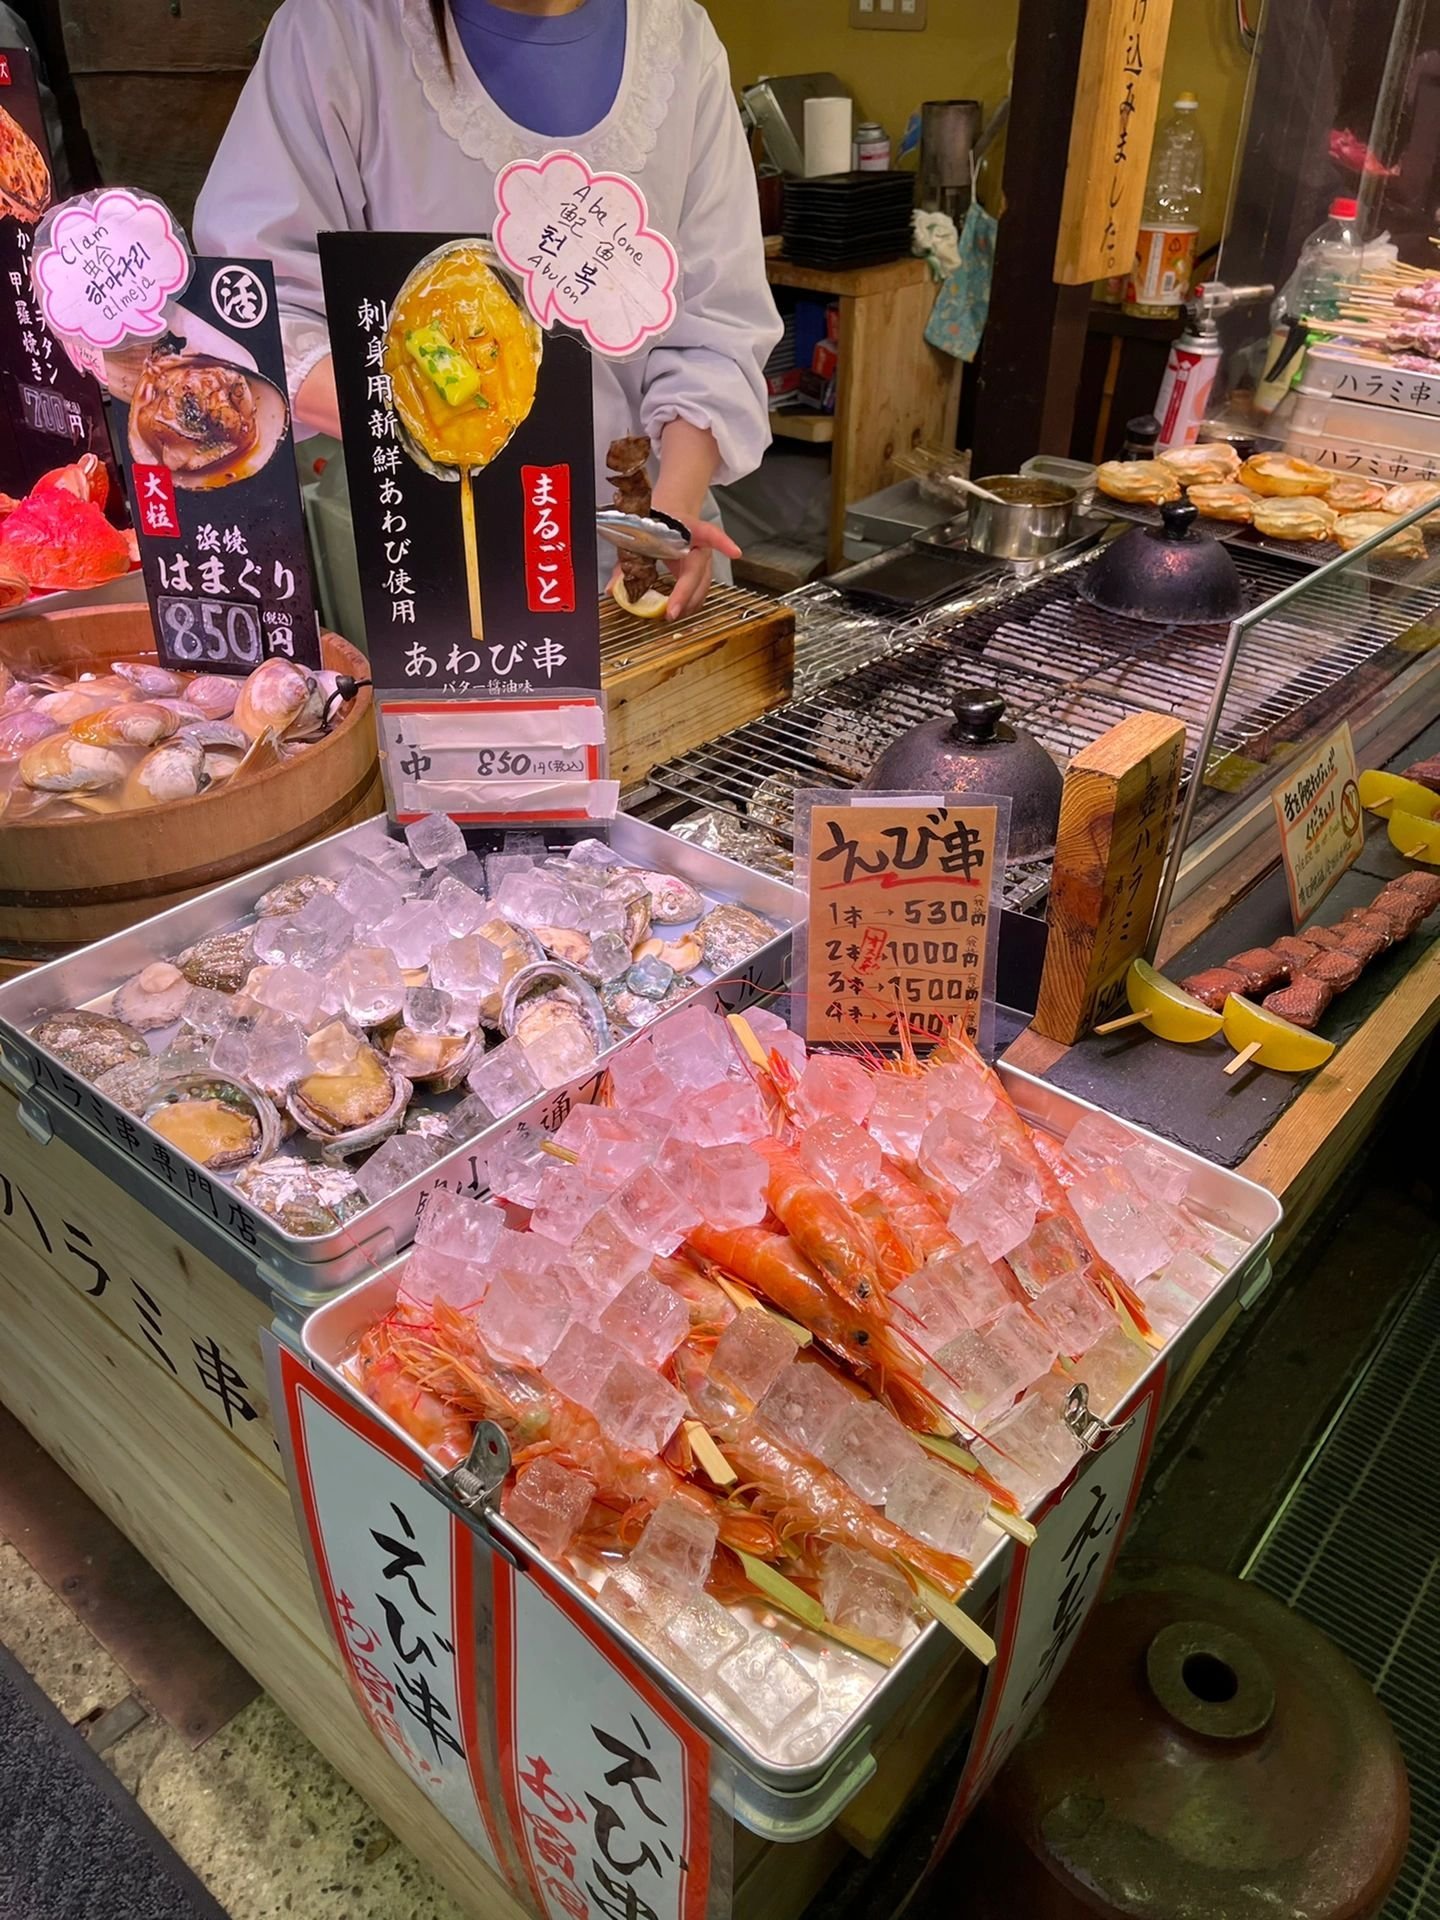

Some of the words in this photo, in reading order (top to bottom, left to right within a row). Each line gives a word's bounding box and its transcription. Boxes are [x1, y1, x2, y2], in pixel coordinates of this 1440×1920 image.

[60, 226, 109, 265] Clam
[102, 276, 156, 320] almeja
[220, 275, 257, 320] 活
[9, 271, 43, 382] 甲羅焼き
[357, 298, 416, 624] 刺身用新鮮あわび使用
[142, 471, 175, 530] 大粒
[195, 523, 249, 555] 浜焼
[531, 473, 565, 606] まるごと
[157, 552, 296, 601] はまぐり
[165, 602, 261, 662] 850
[267, 627, 295, 657] 円
[403, 637, 568, 680] あわび串
[400, 751, 431, 780] 中
[816, 808, 985, 883] えび串
[828, 902, 863, 929] 1本
[904, 899, 968, 924] 530
[825, 940, 861, 964] 2本
[886, 940, 959, 965] 1000
[888, 976, 962, 1002] 1500
[35, 1057, 257, 1246] ハラミ串専門店
[368, 1502, 468, 1766] えび串
